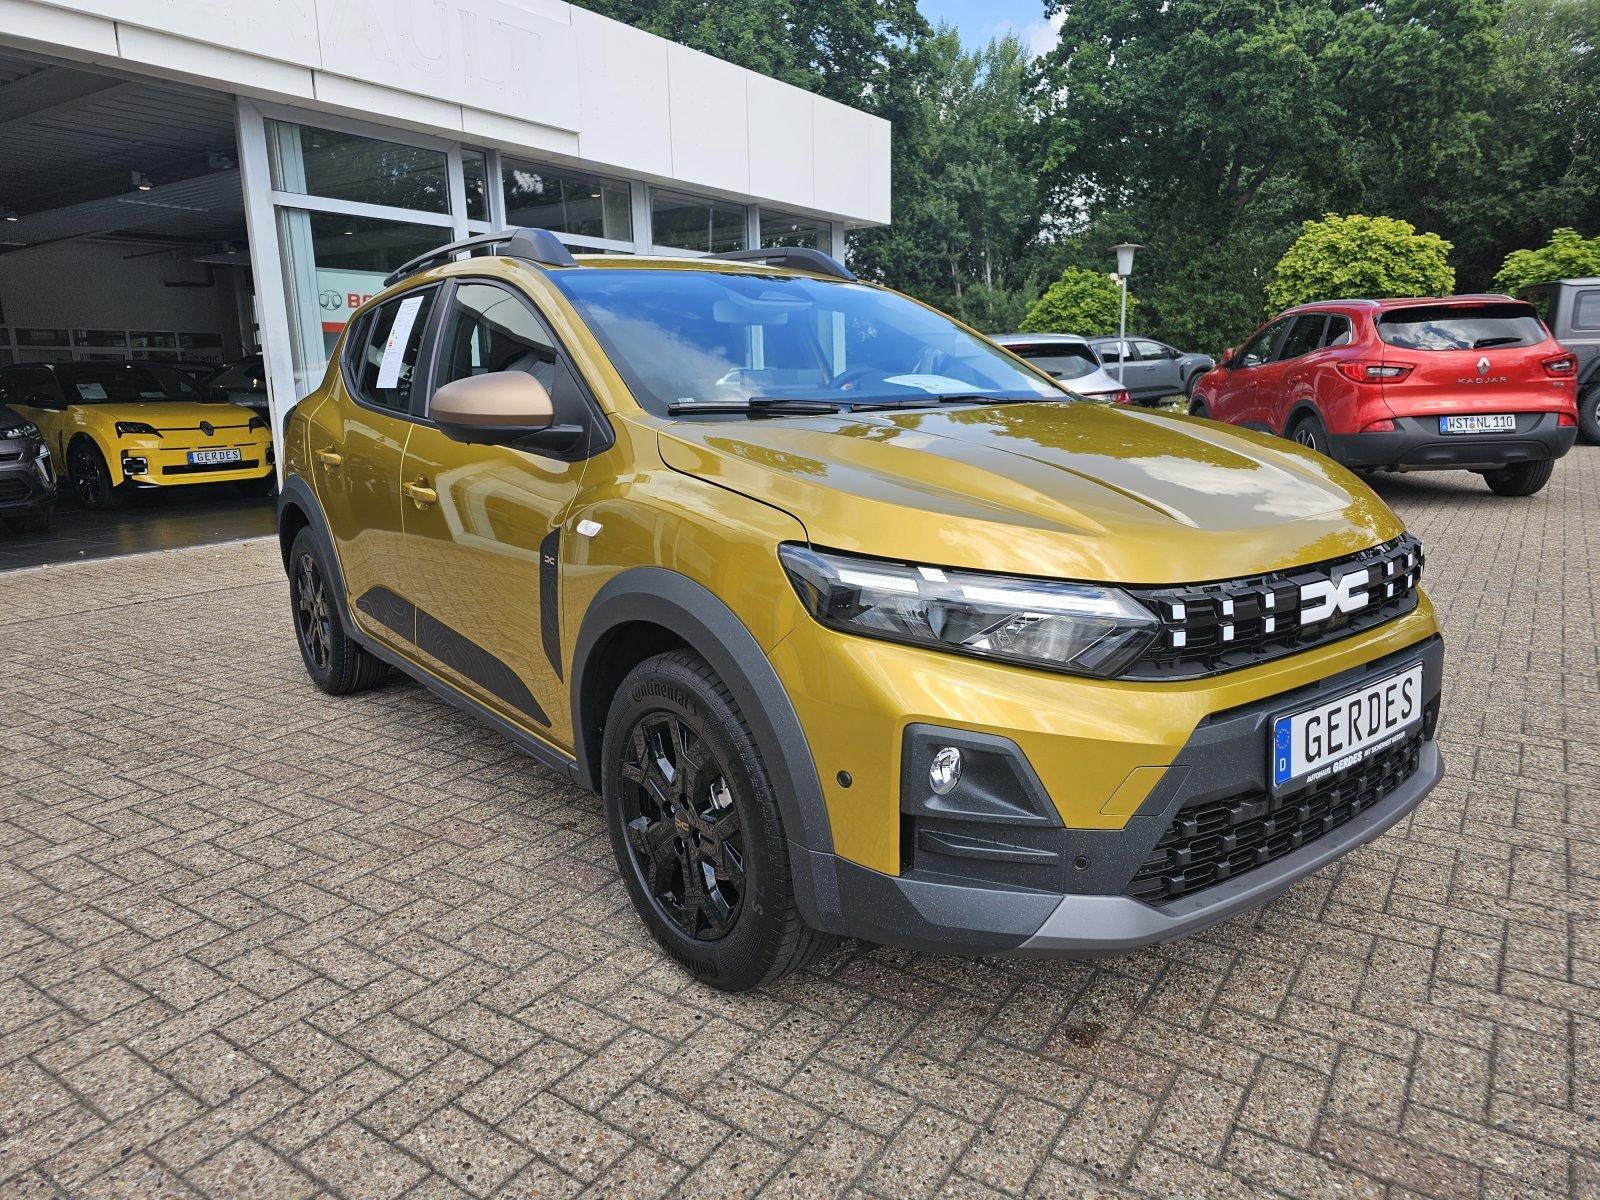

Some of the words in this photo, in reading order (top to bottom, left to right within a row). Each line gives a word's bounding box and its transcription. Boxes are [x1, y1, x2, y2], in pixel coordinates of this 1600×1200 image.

[1456, 376, 1507, 384] KADJAR
[1448, 417, 1469, 429] WST
[1476, 416, 1490, 428] NL
[1493, 416, 1513, 428] 110
[197, 450, 239, 462] GERDES
[632, 679, 689, 710] Continental
[1305, 677, 1413, 763] GERDES
[1279, 757, 1286, 772] D
[1306, 767, 1331, 783] AUTOHAUS
[1333, 751, 1363, 773] GERDES
